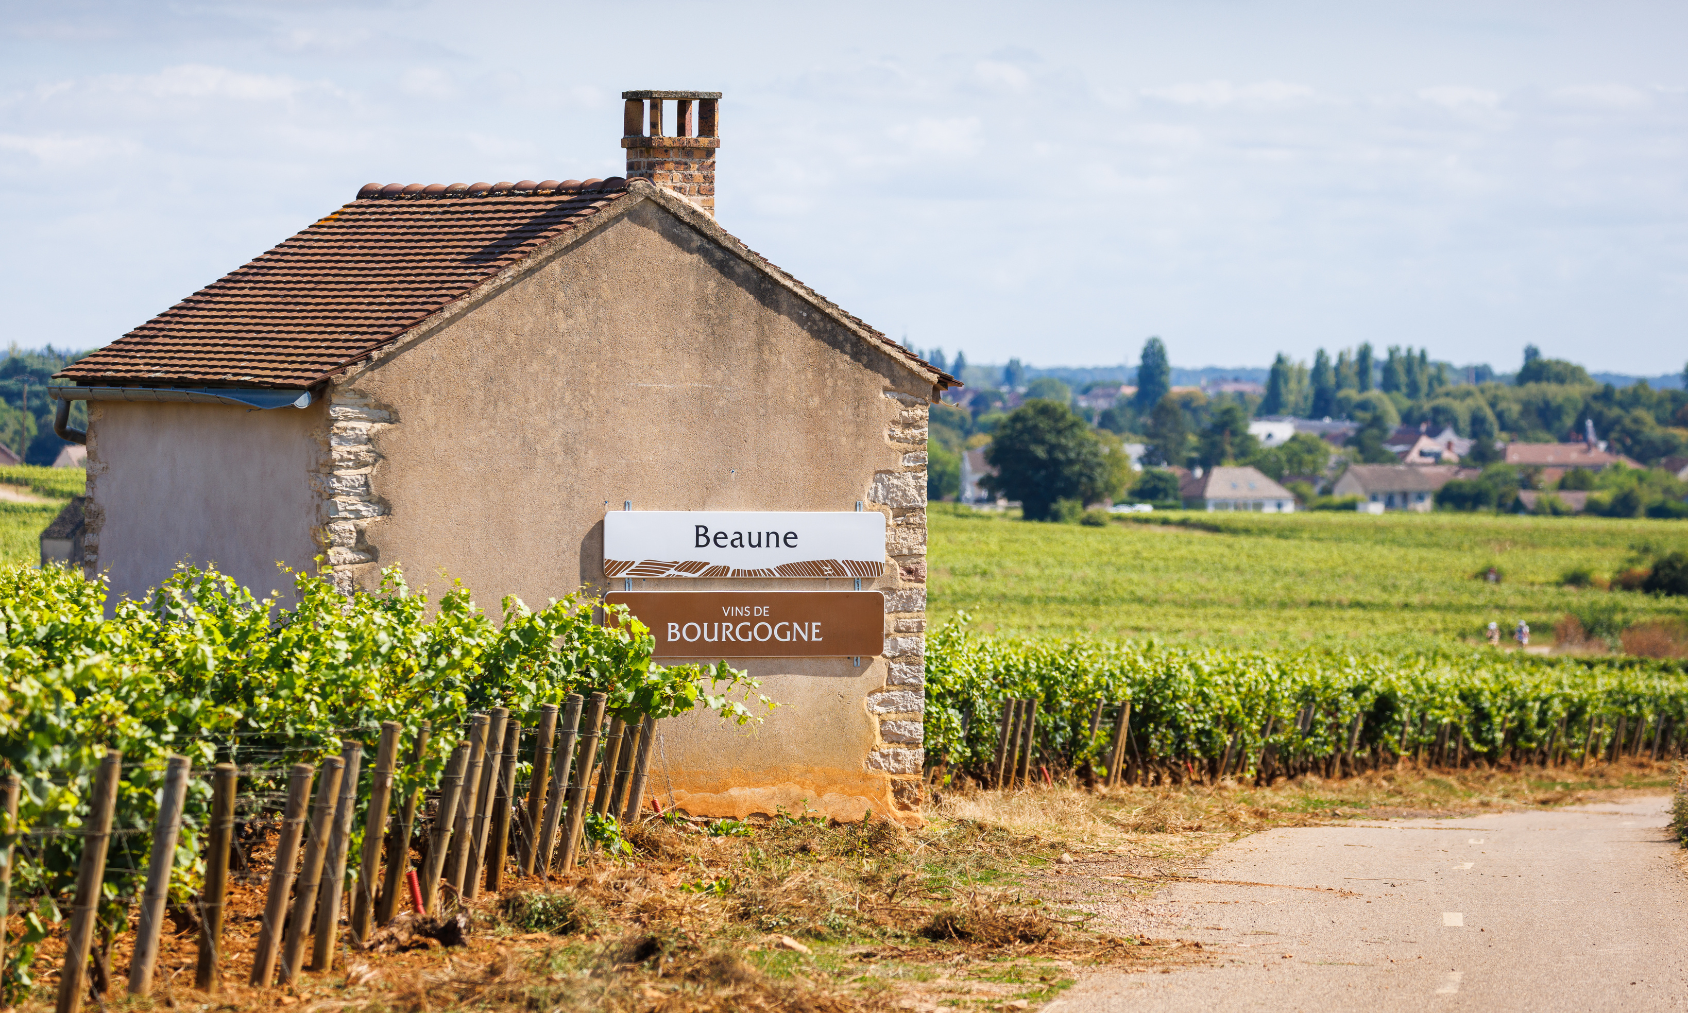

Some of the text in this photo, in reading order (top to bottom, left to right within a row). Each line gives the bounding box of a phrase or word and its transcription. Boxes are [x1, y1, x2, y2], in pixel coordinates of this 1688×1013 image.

[694, 524, 799, 549] Beaune
[722, 606, 770, 617] VINS DE
[666, 622, 824, 642] BOURGOGNE
